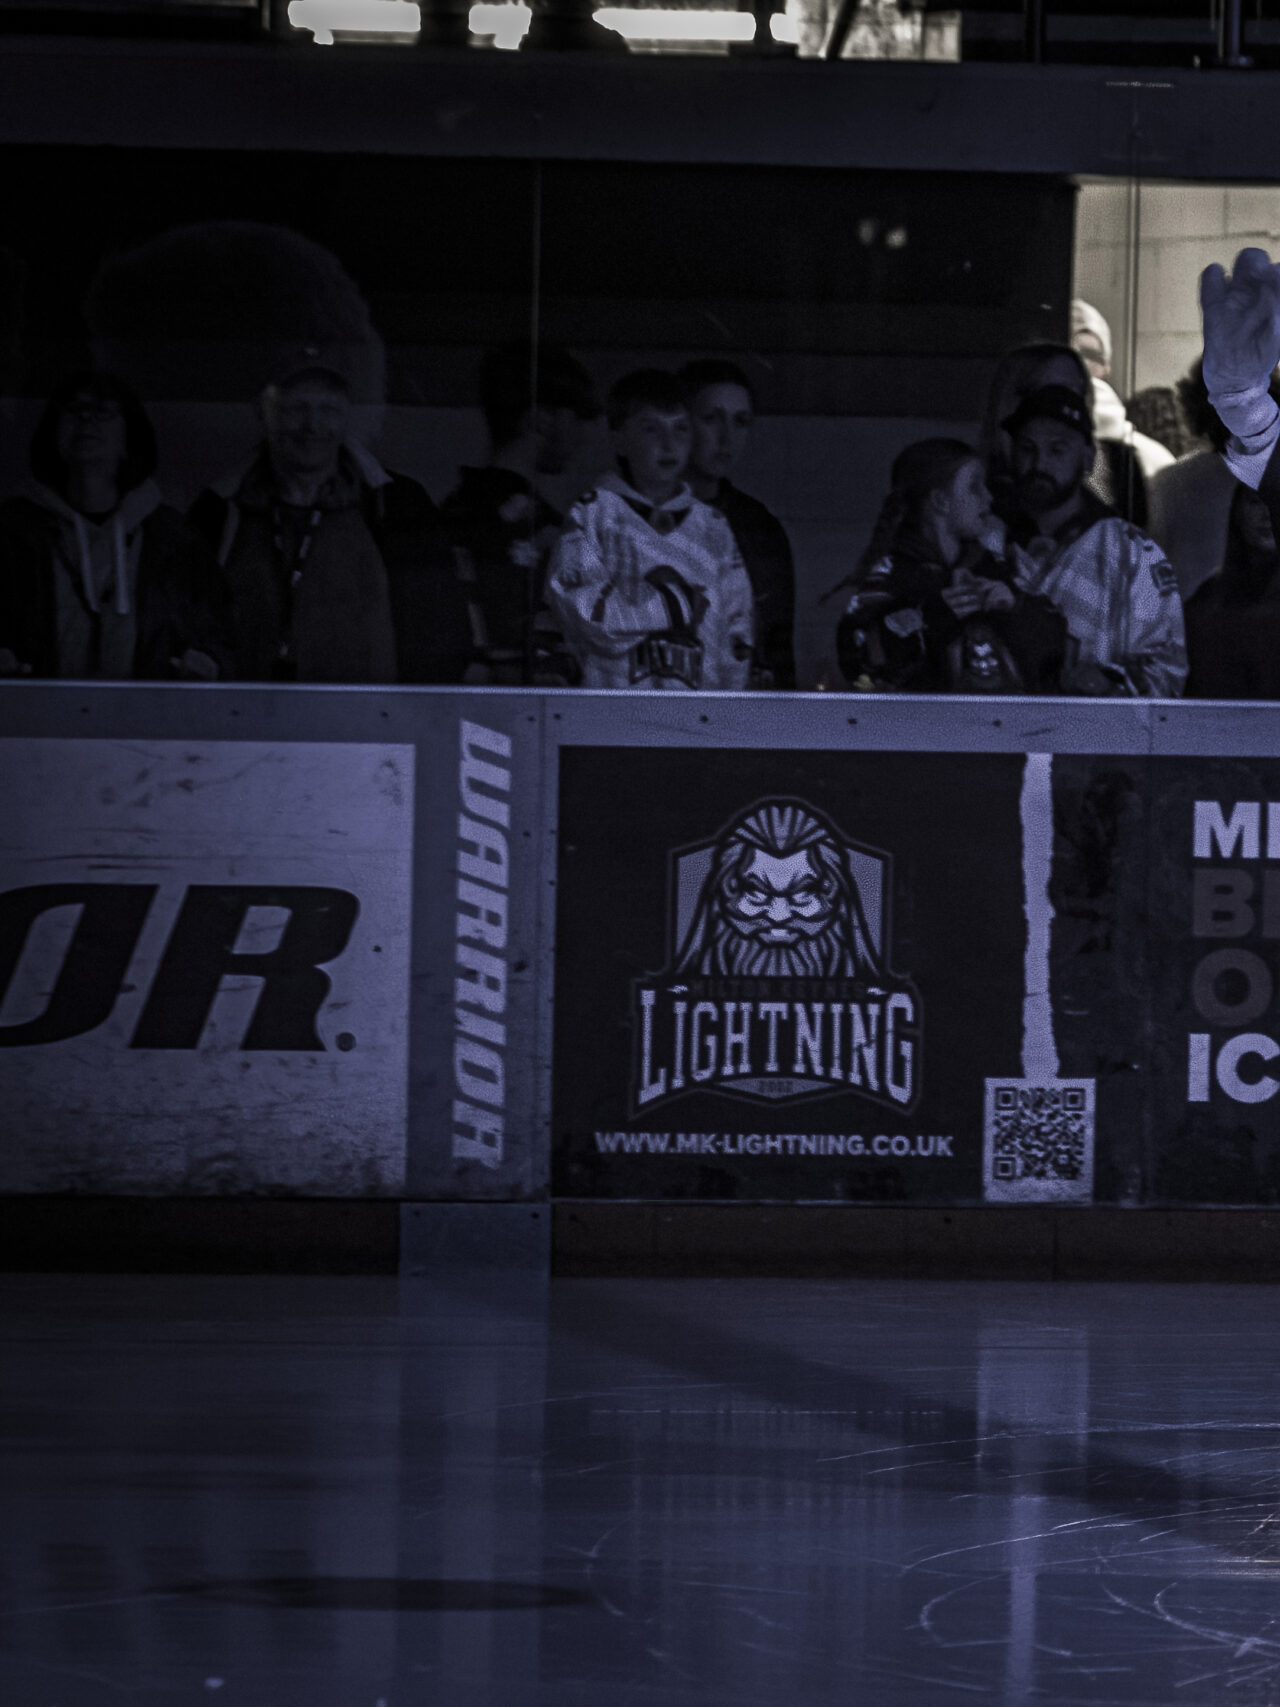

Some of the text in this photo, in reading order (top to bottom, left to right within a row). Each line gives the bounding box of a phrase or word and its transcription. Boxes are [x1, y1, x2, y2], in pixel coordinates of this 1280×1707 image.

[451, 718, 511, 1170] WARRIOR
[638, 988, 915, 1105] LIGHTNING
[594, 1131, 954, 1158] WWW.MK-LIGHTNING.CO.UK
